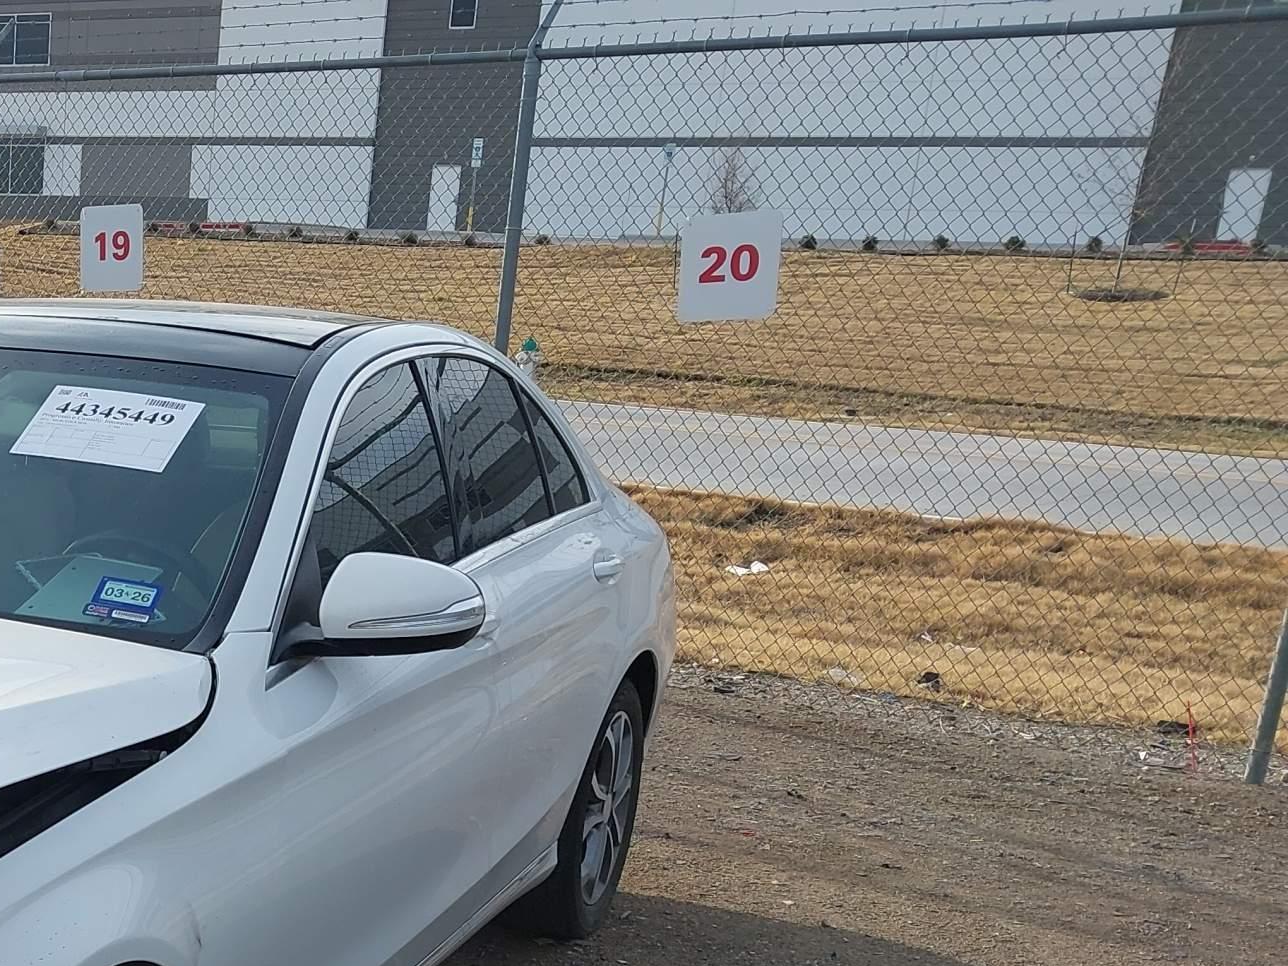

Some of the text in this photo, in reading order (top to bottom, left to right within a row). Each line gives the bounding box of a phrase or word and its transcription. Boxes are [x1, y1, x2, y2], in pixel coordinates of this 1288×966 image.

[93, 230, 131, 261] 19
[699, 242, 760, 284] 20
[55, 401, 176, 426] 44345449
[104, 587, 124, 598] 03
[131, 591, 151, 602] 26
